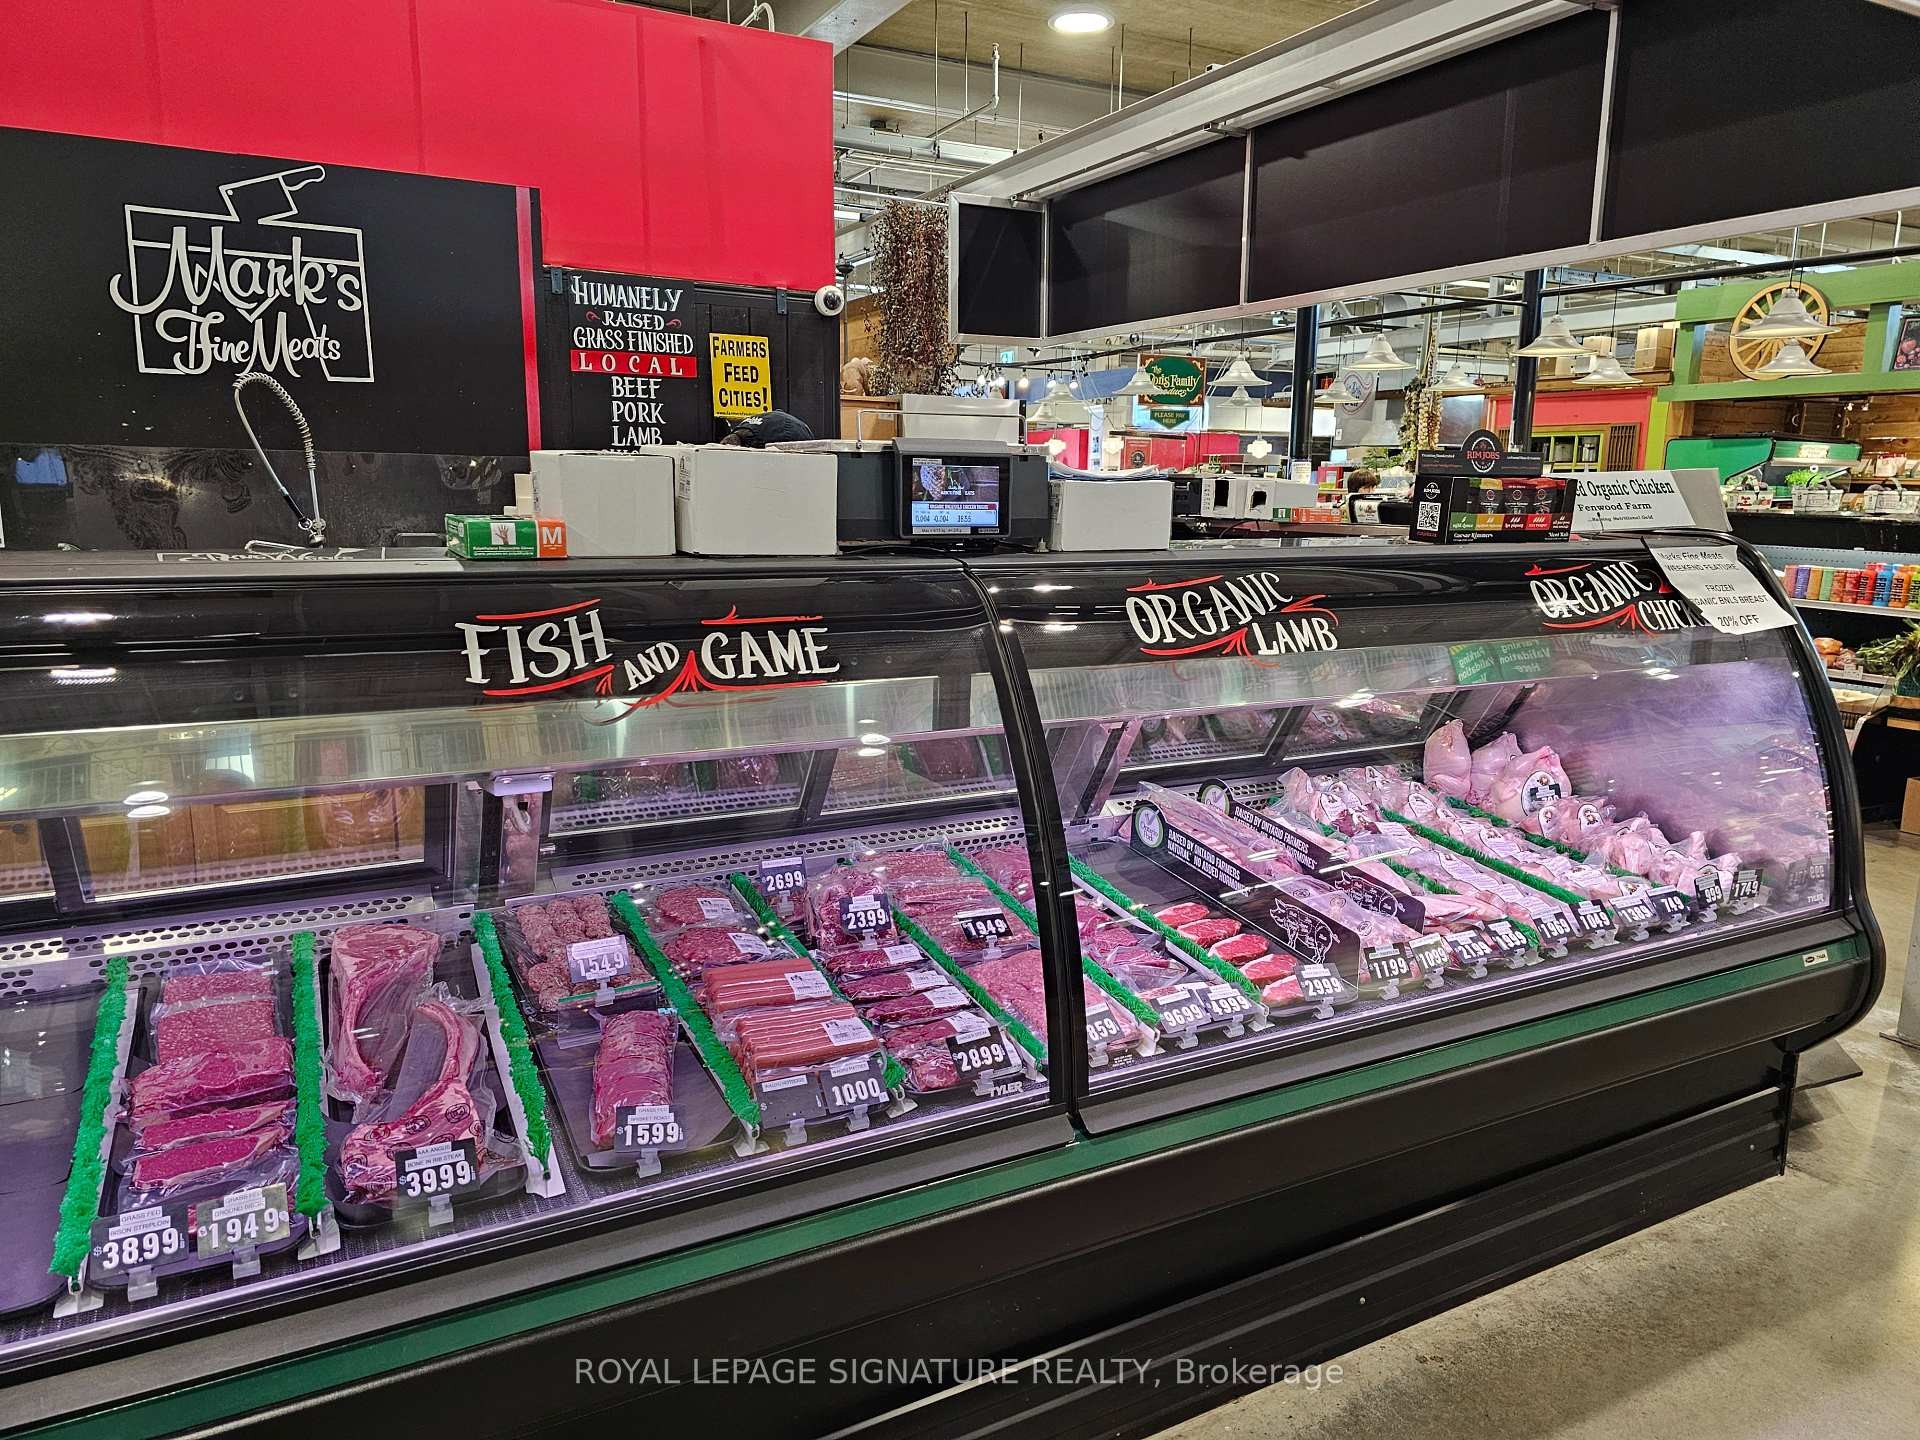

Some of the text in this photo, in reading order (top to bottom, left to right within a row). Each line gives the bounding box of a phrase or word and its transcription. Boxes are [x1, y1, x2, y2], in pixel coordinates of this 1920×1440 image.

[109, 226, 364, 315] Mark's
[571, 275, 684, 311] HUMANELY
[602, 311, 665, 330] RAISED
[155, 309, 341, 378] Fine Meats
[573, 327, 693, 354] GRASS FINISHED
[712, 337, 767, 358] FARMERS
[579, 352, 684, 375] LOCAL
[724, 362, 759, 383] FEED
[612, 376, 662, 399] BEEF
[1170, 374, 1201, 392] Family
[719, 387, 768, 411] CITIES!
[612, 400, 666, 424] PORK
[612, 426, 663, 447] LAMB
[1587, 480, 1630, 500] Organic
[1629, 478, 1675, 495] Chicken
[1578, 503, 1622, 511] Fenwood
[543, 527, 562, 545] M
[1700, 552, 1723, 560] Meats
[1530, 561, 1653, 618] ORGANIC
[1705, 584, 1736, 592] FROZEN
[1739, 595, 1768, 603] BREAST
[1126, 572, 1293, 644] ORGANIC
[1718, 615, 1760, 627] 20% OFF
[1252, 618, 1338, 655] LAMB
[455, 608, 839, 691] FISH AND GAME
[1235, 806, 1253, 824] RAISED
[1253, 816, 1260, 827] BY
[1261, 818, 1284, 839] ONTARIO
[1284, 830, 1309, 853] FARMERS
[1169, 829, 1186, 848] RAISED
[1186, 840, 1194, 851] BY
[1194, 843, 1215, 864] ONTARIO
[1215, 854, 1241, 880] FARMERS
[1193, 856, 1201, 867] NO
[1201, 861, 1219, 879] ADDED
[990, 1081, 1024, 1097] TYLER
[442, 1153, 463, 1162] STEAK
[121, 1208, 161, 1223] GRASS FED
[214, 1205, 242, 1218] GROUND
[93, 1227, 179, 1269] $38.99
